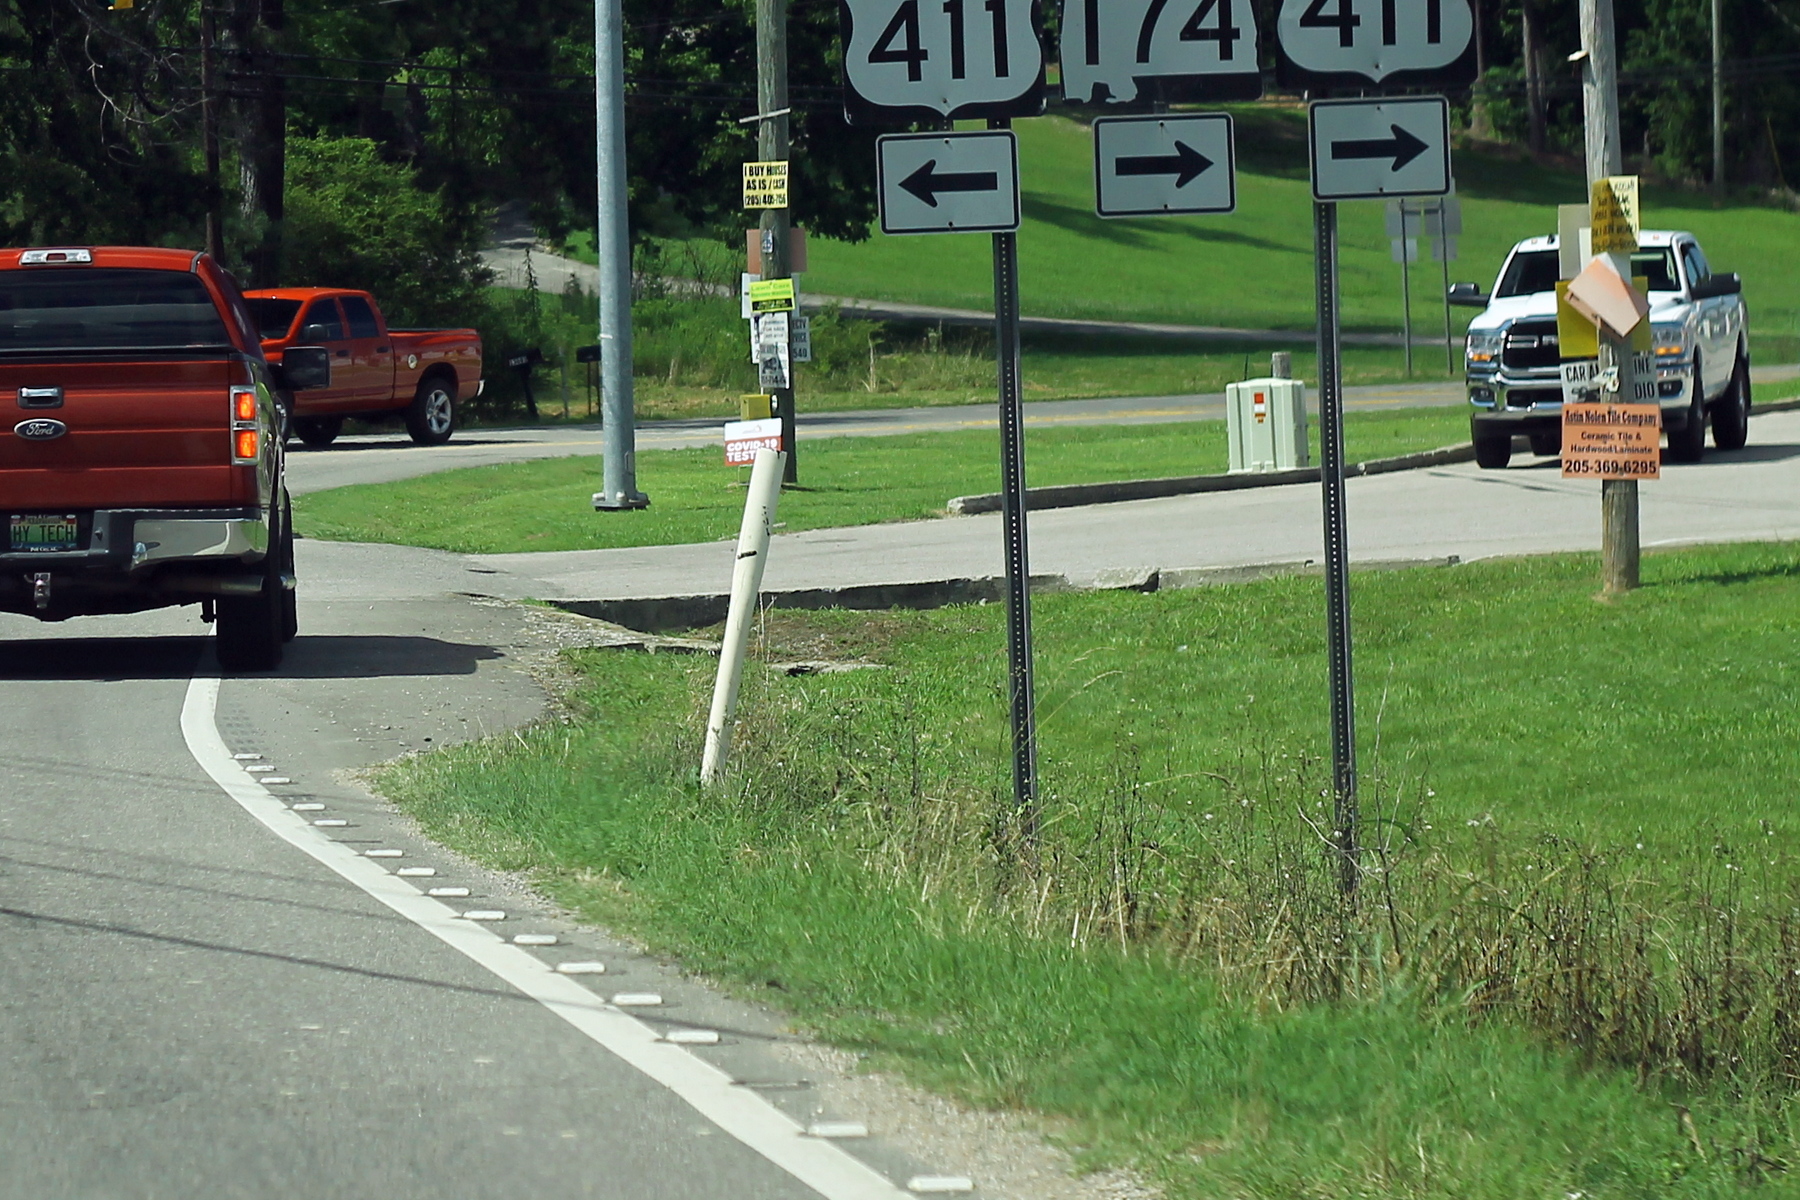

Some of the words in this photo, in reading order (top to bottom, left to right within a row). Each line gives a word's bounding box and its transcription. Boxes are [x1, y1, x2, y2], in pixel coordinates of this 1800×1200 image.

[749, 165, 764, 176] BUY
[746, 179, 756, 190] AS
[759, 179, 766, 190] IS
[1566, 365, 1586, 382] CAR
[1622, 411, 1656, 426] Company
[1581, 432, 1615, 440] Ceramic
[726, 438, 778, 452] COVID-19
[1565, 460, 1656, 474] 205-369-6295
[13, 525, 30, 542] HY
[40, 525, 74, 542] TECH
